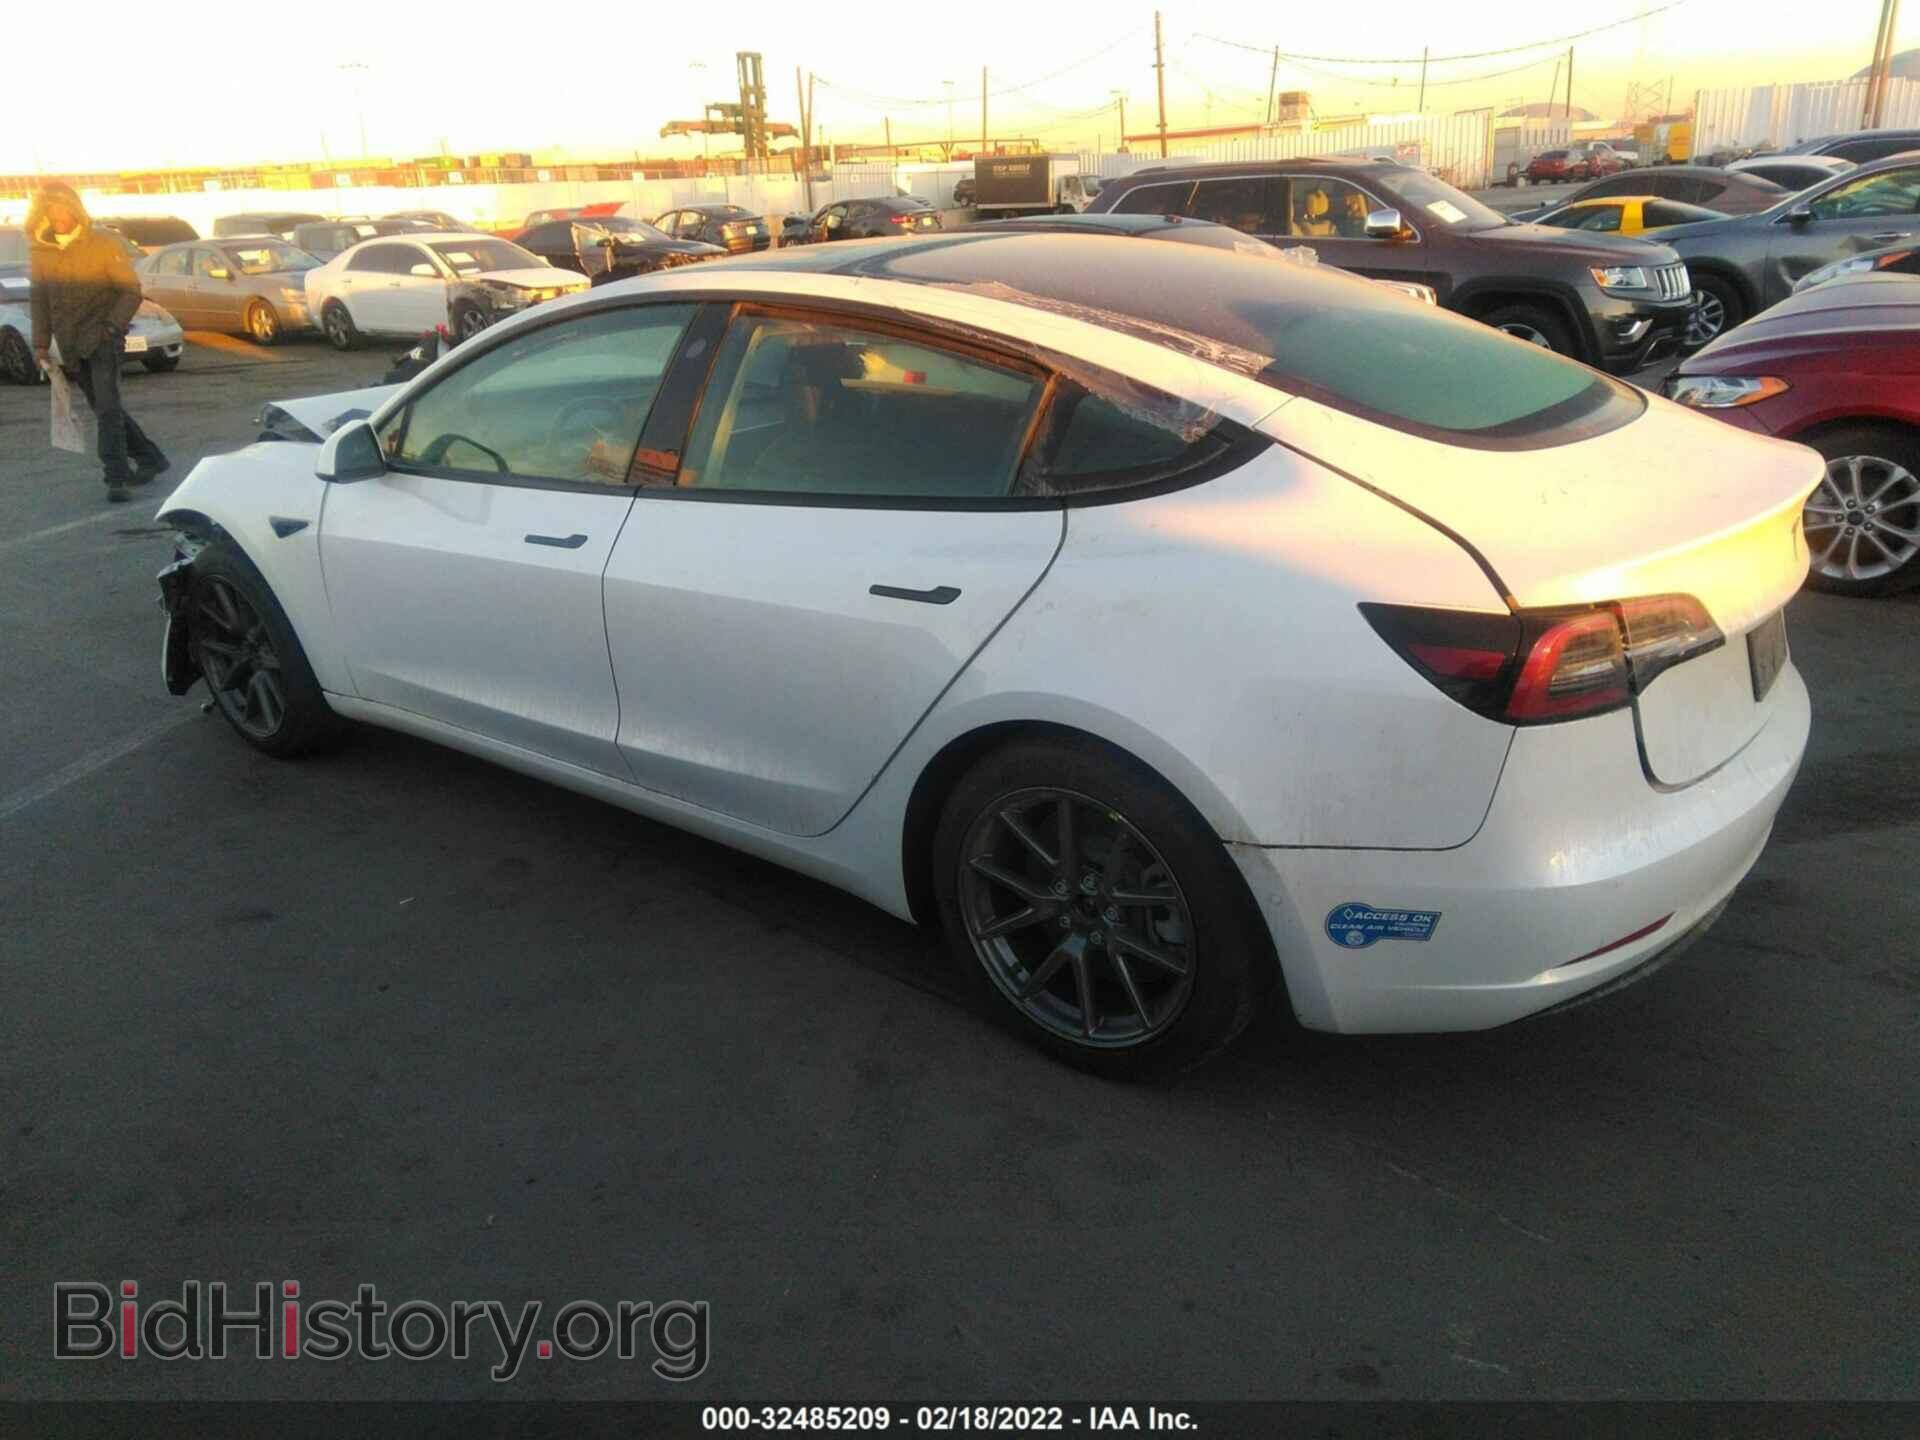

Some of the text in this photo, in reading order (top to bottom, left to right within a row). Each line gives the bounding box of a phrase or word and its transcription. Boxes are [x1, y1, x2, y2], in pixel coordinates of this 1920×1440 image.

[1353, 911, 1433, 923] ACCESS OK
[1387, 925, 1430, 933] VEHICLE
